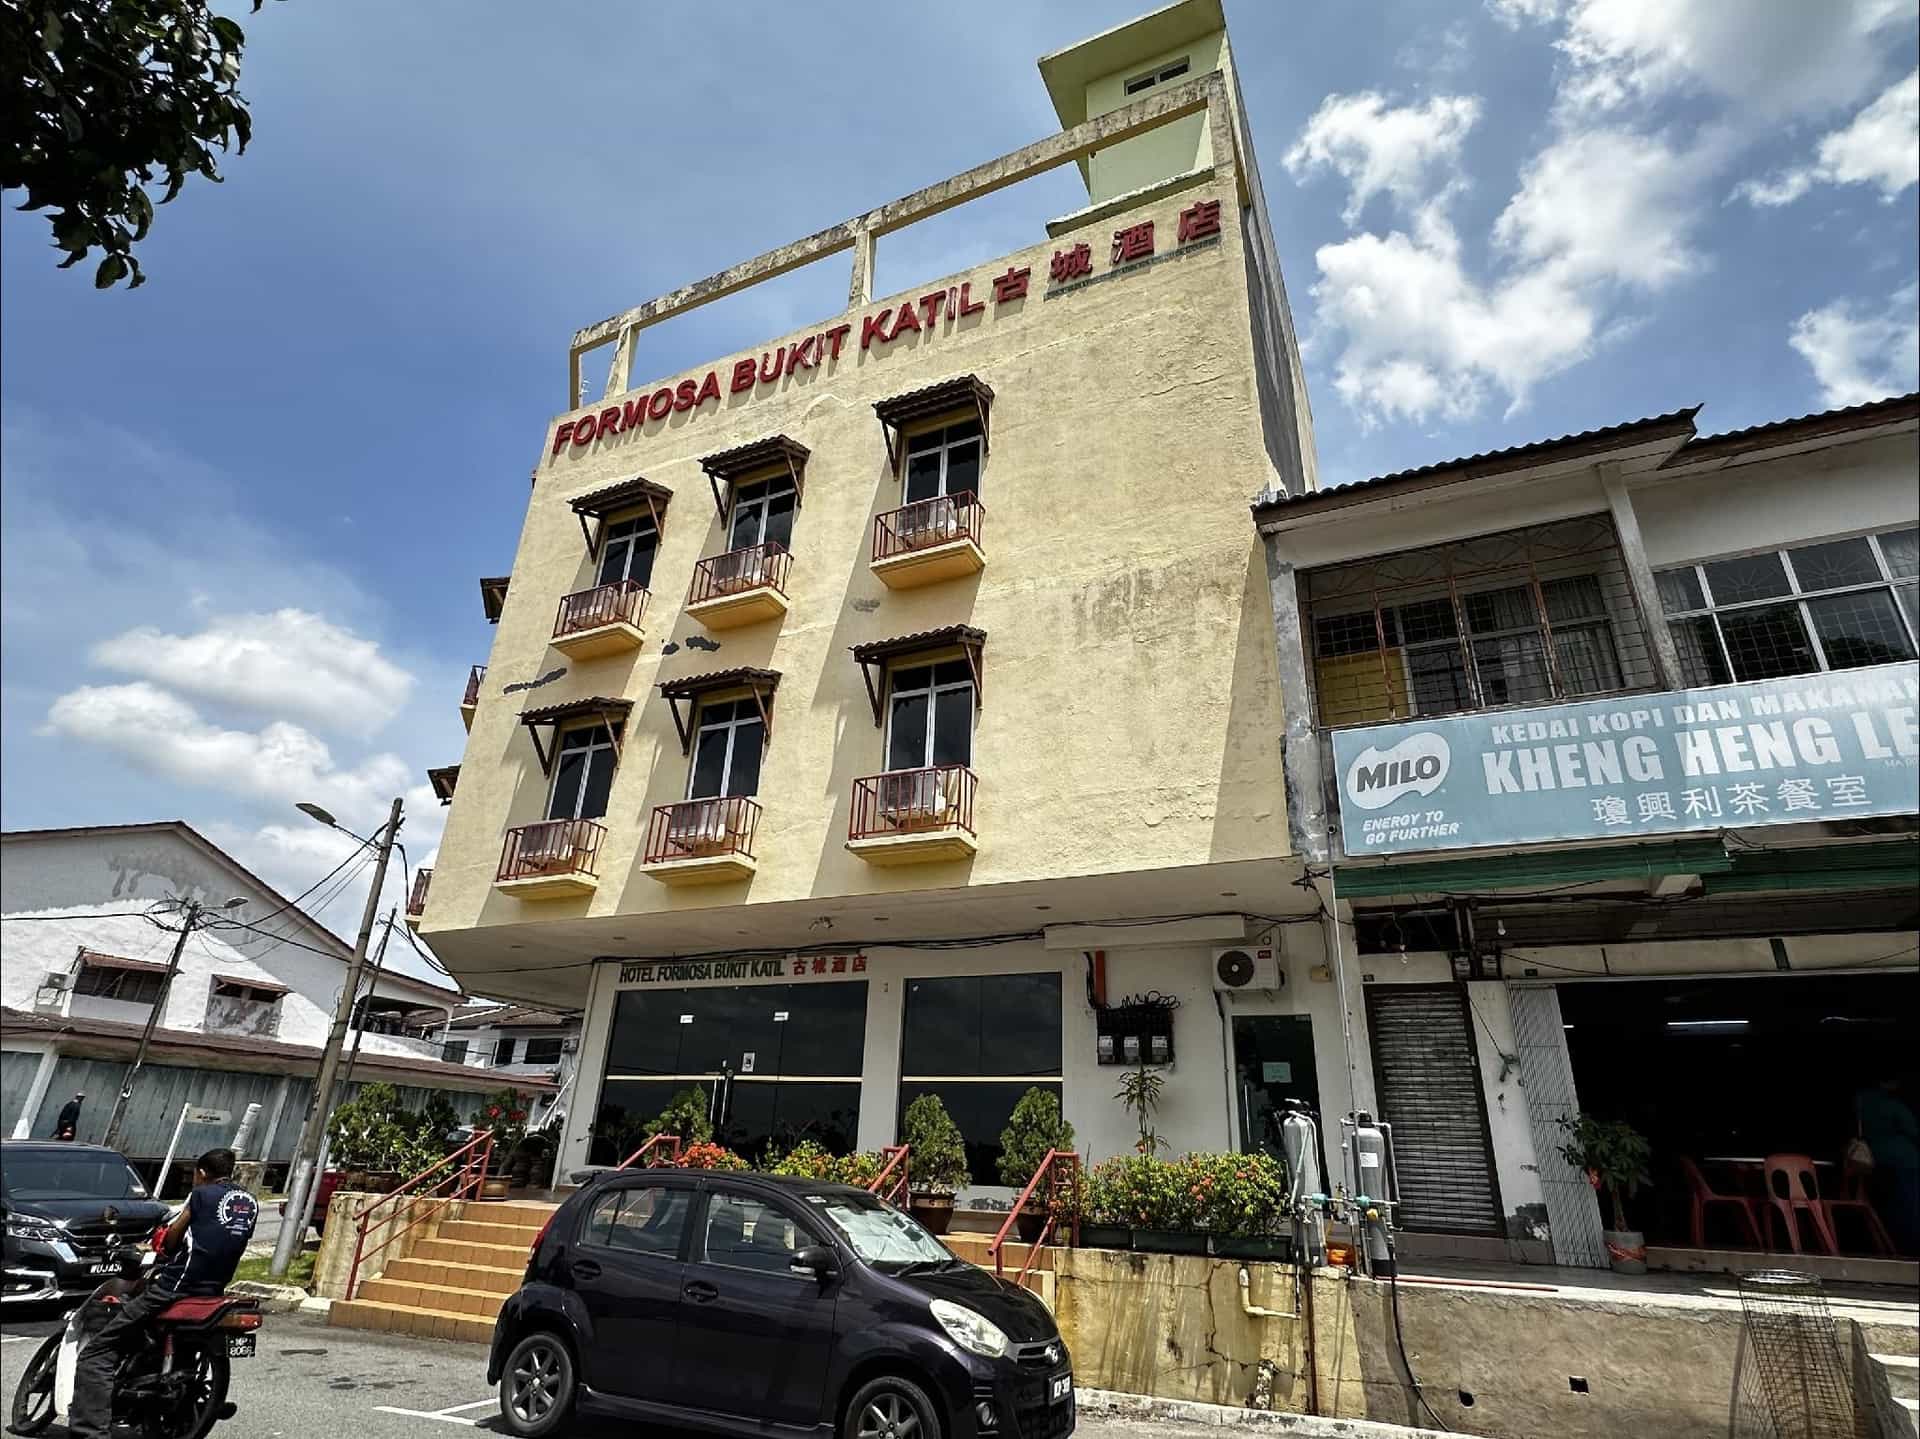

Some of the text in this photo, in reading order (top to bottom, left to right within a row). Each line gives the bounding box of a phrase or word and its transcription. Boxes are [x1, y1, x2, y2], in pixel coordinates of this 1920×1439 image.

[992, 200, 1221, 301] 古城酒店
[552, 282, 985, 455] FORMOSA BUKIT KATIL
[1491, 718, 1580, 745] KEDAI
[1587, 708, 1665, 734] KOPI
[1672, 699, 1742, 724] DAN
[1357, 755, 1441, 793] MILO
[1482, 736, 1664, 795] KHENG
[1674, 717, 1841, 776] HENG
[1362, 810, 1444, 832] ENERGY TO
[1365, 822, 1460, 846] GO FURTHER
[619, 966, 655, 984] HOTEL
[656, 962, 713, 982] FORMOSA
[750, 958, 785, 978] KATIL
